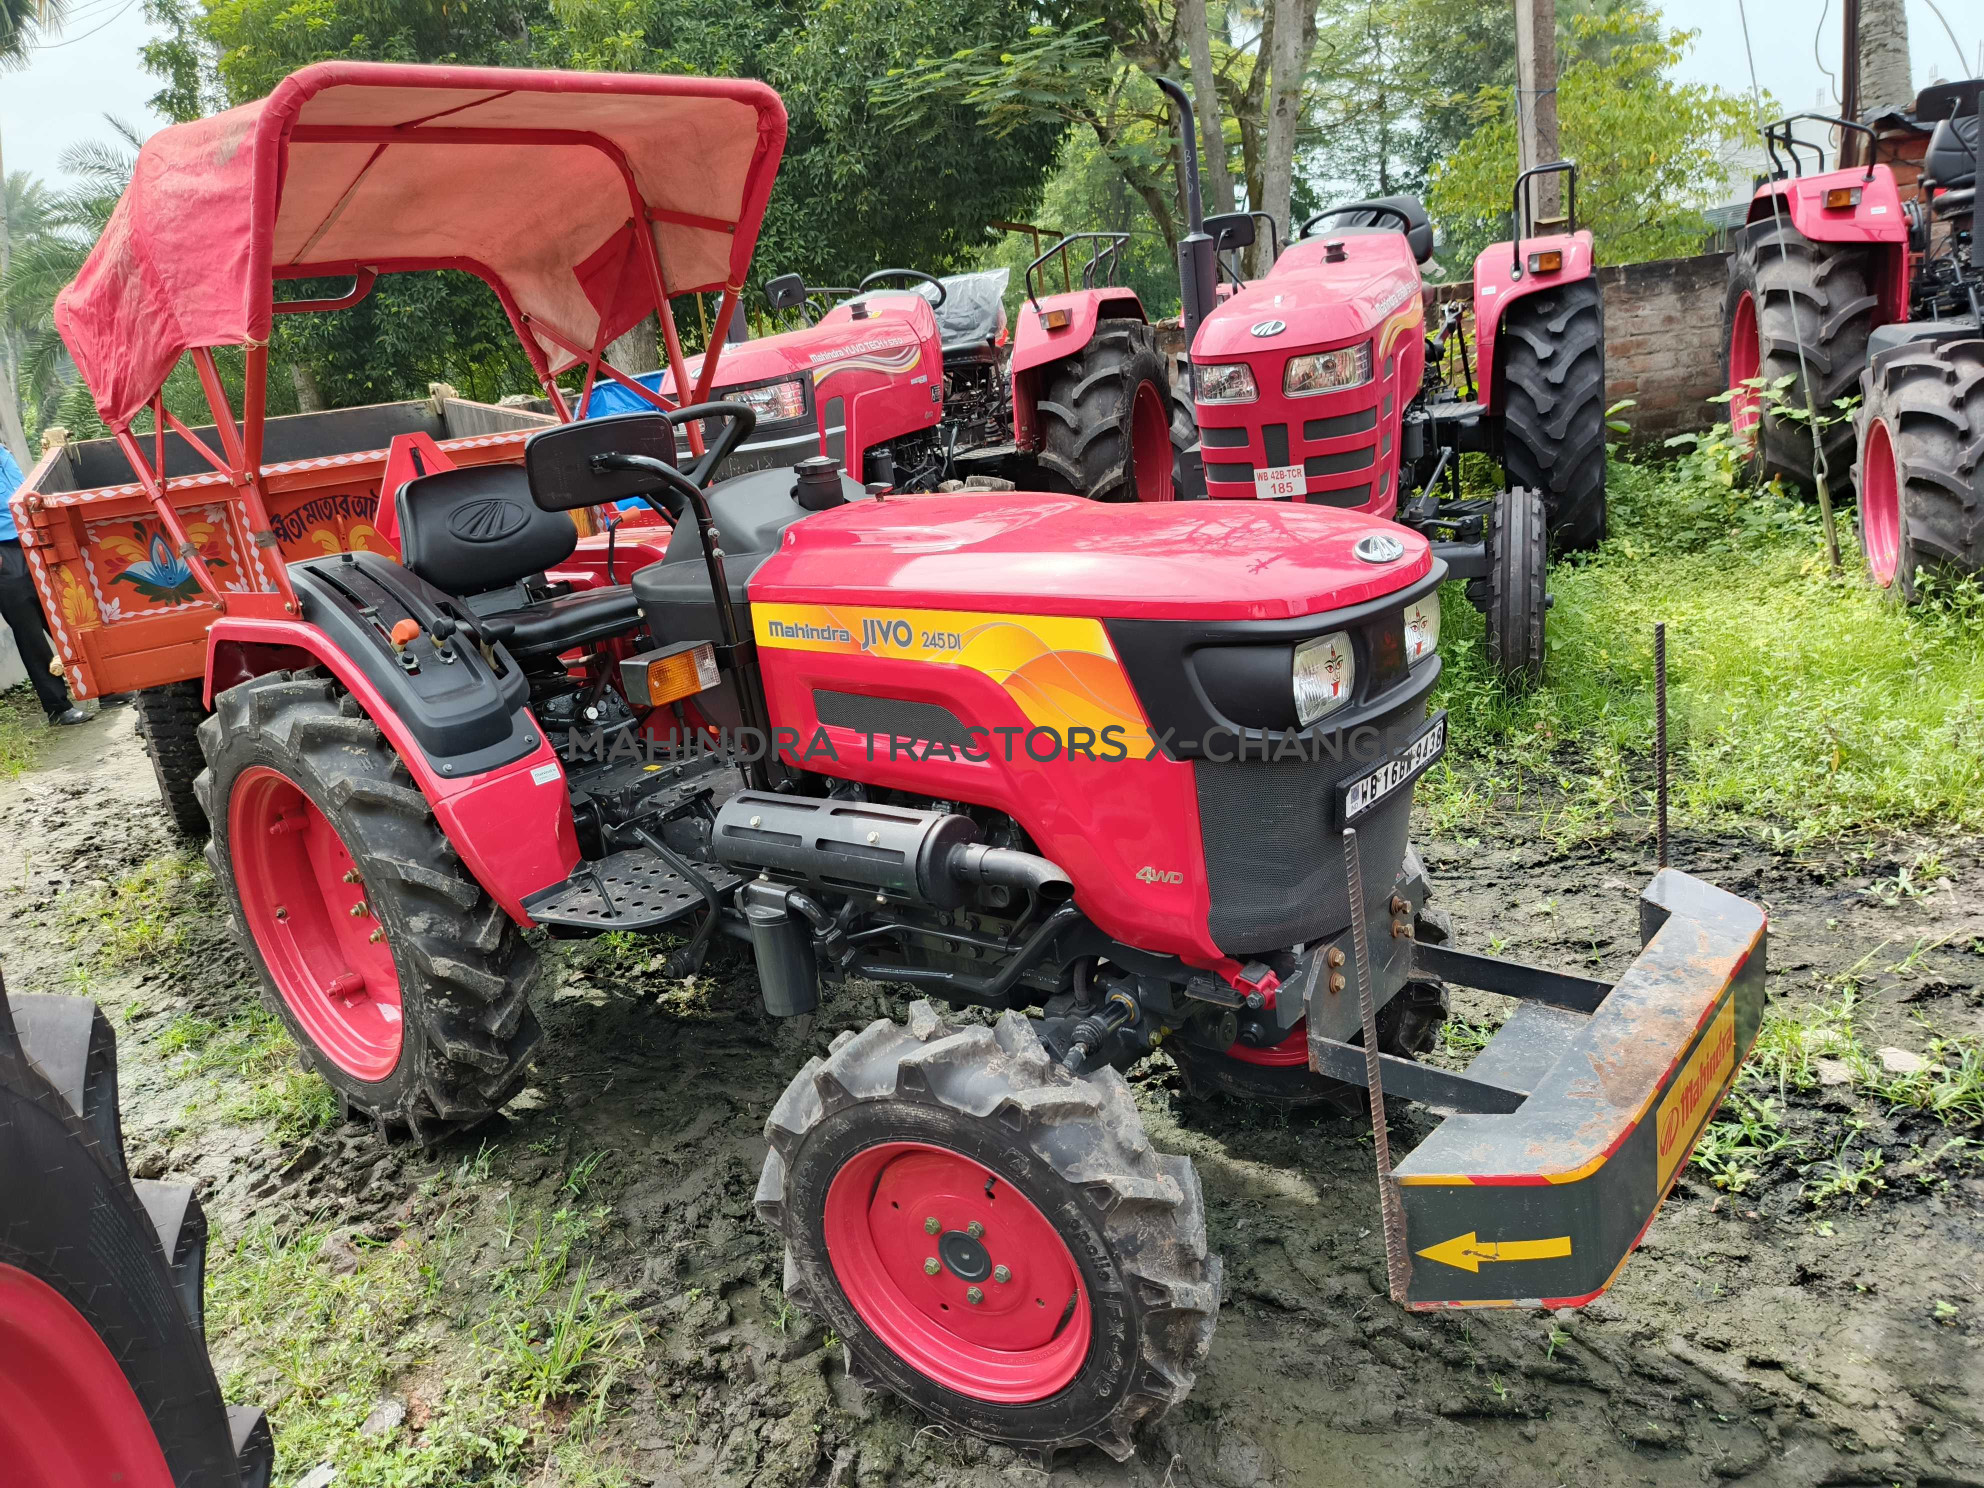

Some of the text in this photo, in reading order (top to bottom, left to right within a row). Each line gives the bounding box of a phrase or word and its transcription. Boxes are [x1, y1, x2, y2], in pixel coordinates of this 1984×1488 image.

[808, 349, 844, 364] Mahindra
[842, 343, 866, 356] YUVO
[1257, 469, 1303, 481] WB 42B-TCR
[1271, 482, 1294, 494] 185
[302, 494, 352, 524] মাতার
[768, 619, 850, 643] Mahindra
[861, 618, 913, 651] JIVO
[1361, 775, 1378, 804] WB
[1135, 866, 1184, 884] 4WD
[1680, 1023, 1733, 1129] Mahindra
[1067, 1218, 1111, 1283] apollo
